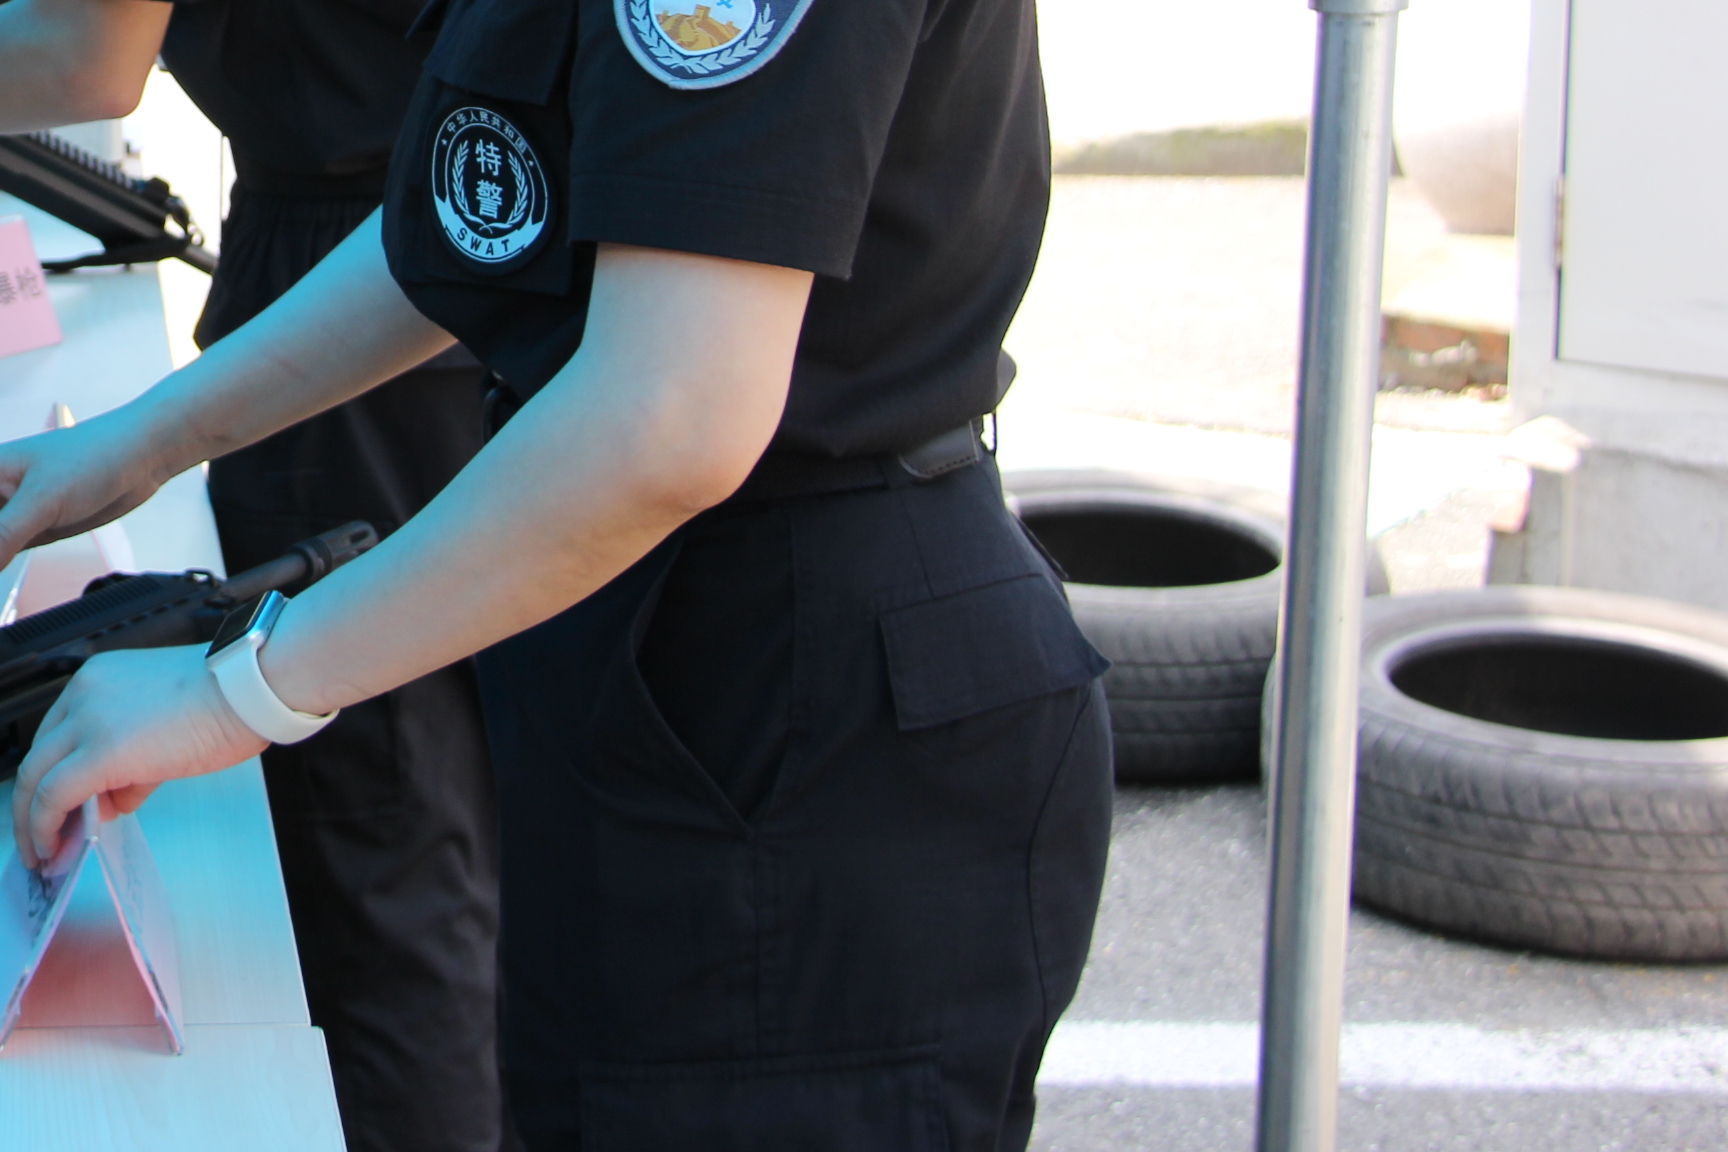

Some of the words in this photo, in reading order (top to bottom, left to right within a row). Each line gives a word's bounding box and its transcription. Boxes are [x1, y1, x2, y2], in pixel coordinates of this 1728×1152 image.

[446, 109, 529, 154] 中华人民共和国
[475, 138, 504, 219] 特警
[456, 227, 511, 257] SWAT
